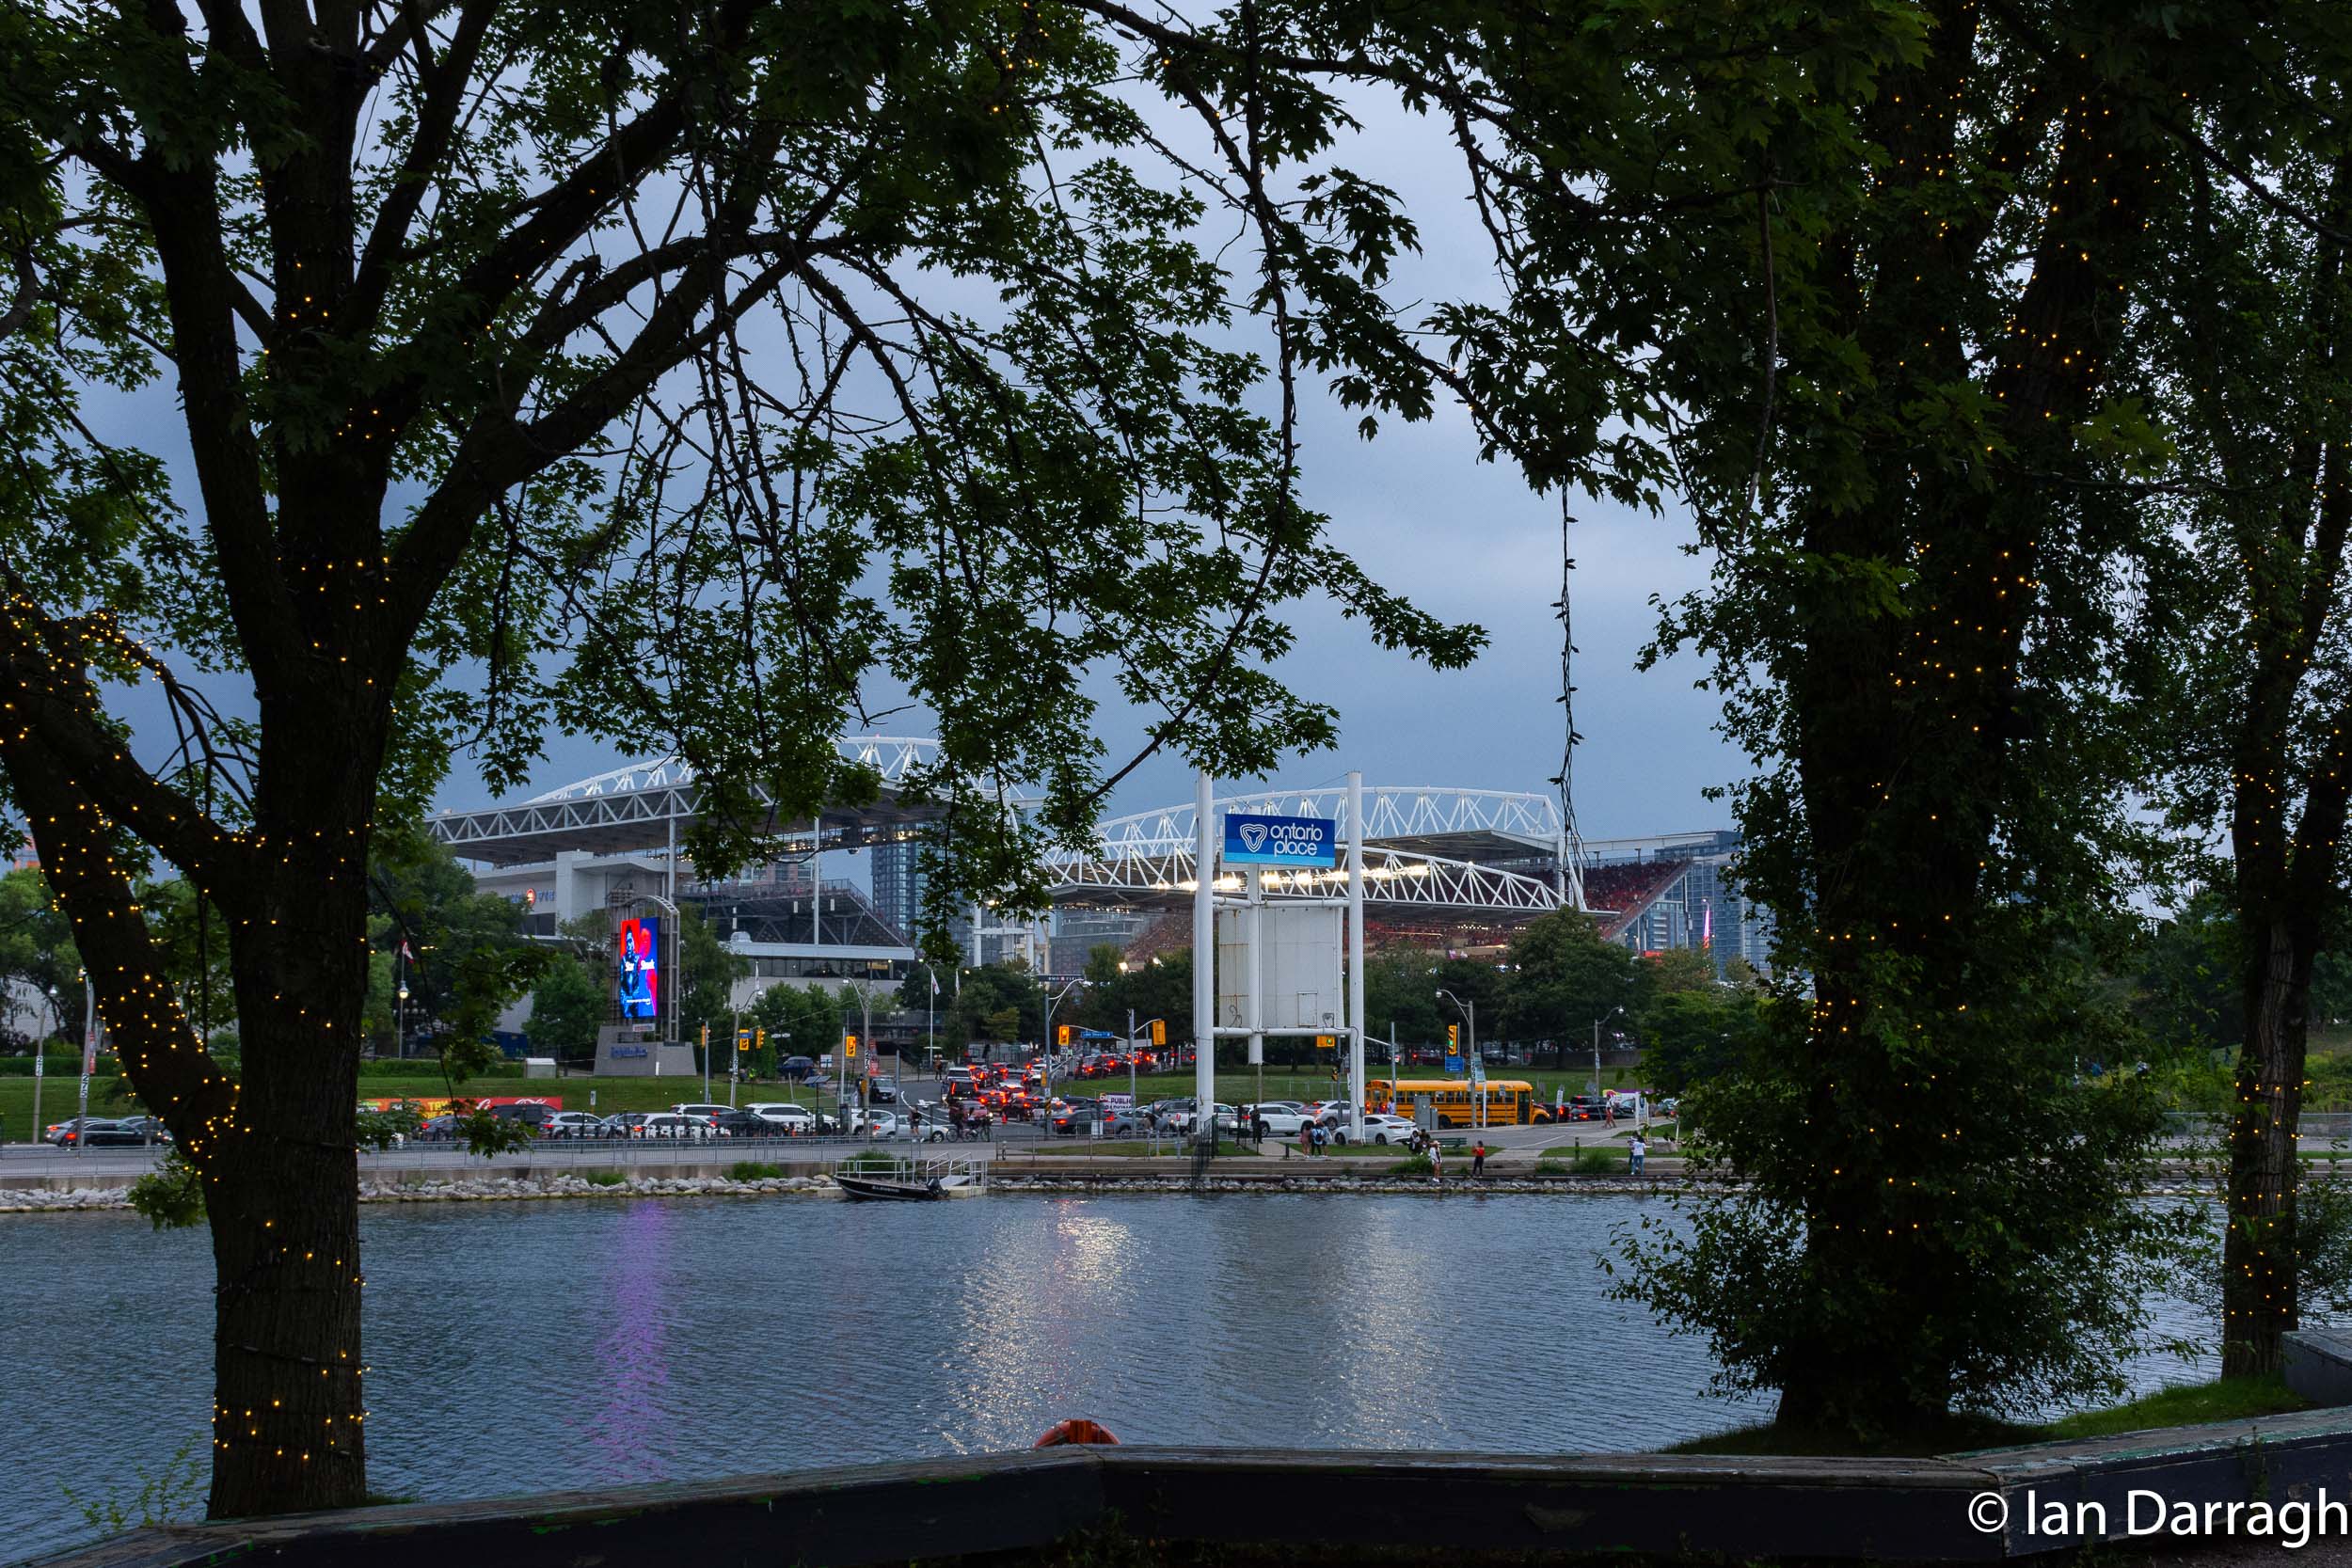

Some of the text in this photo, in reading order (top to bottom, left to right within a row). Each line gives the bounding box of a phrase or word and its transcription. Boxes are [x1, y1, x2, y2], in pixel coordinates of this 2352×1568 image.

[1270, 822, 1323, 842] ontario
[1274, 835, 1317, 858] place
[81, 1073, 90, 1099] 275
